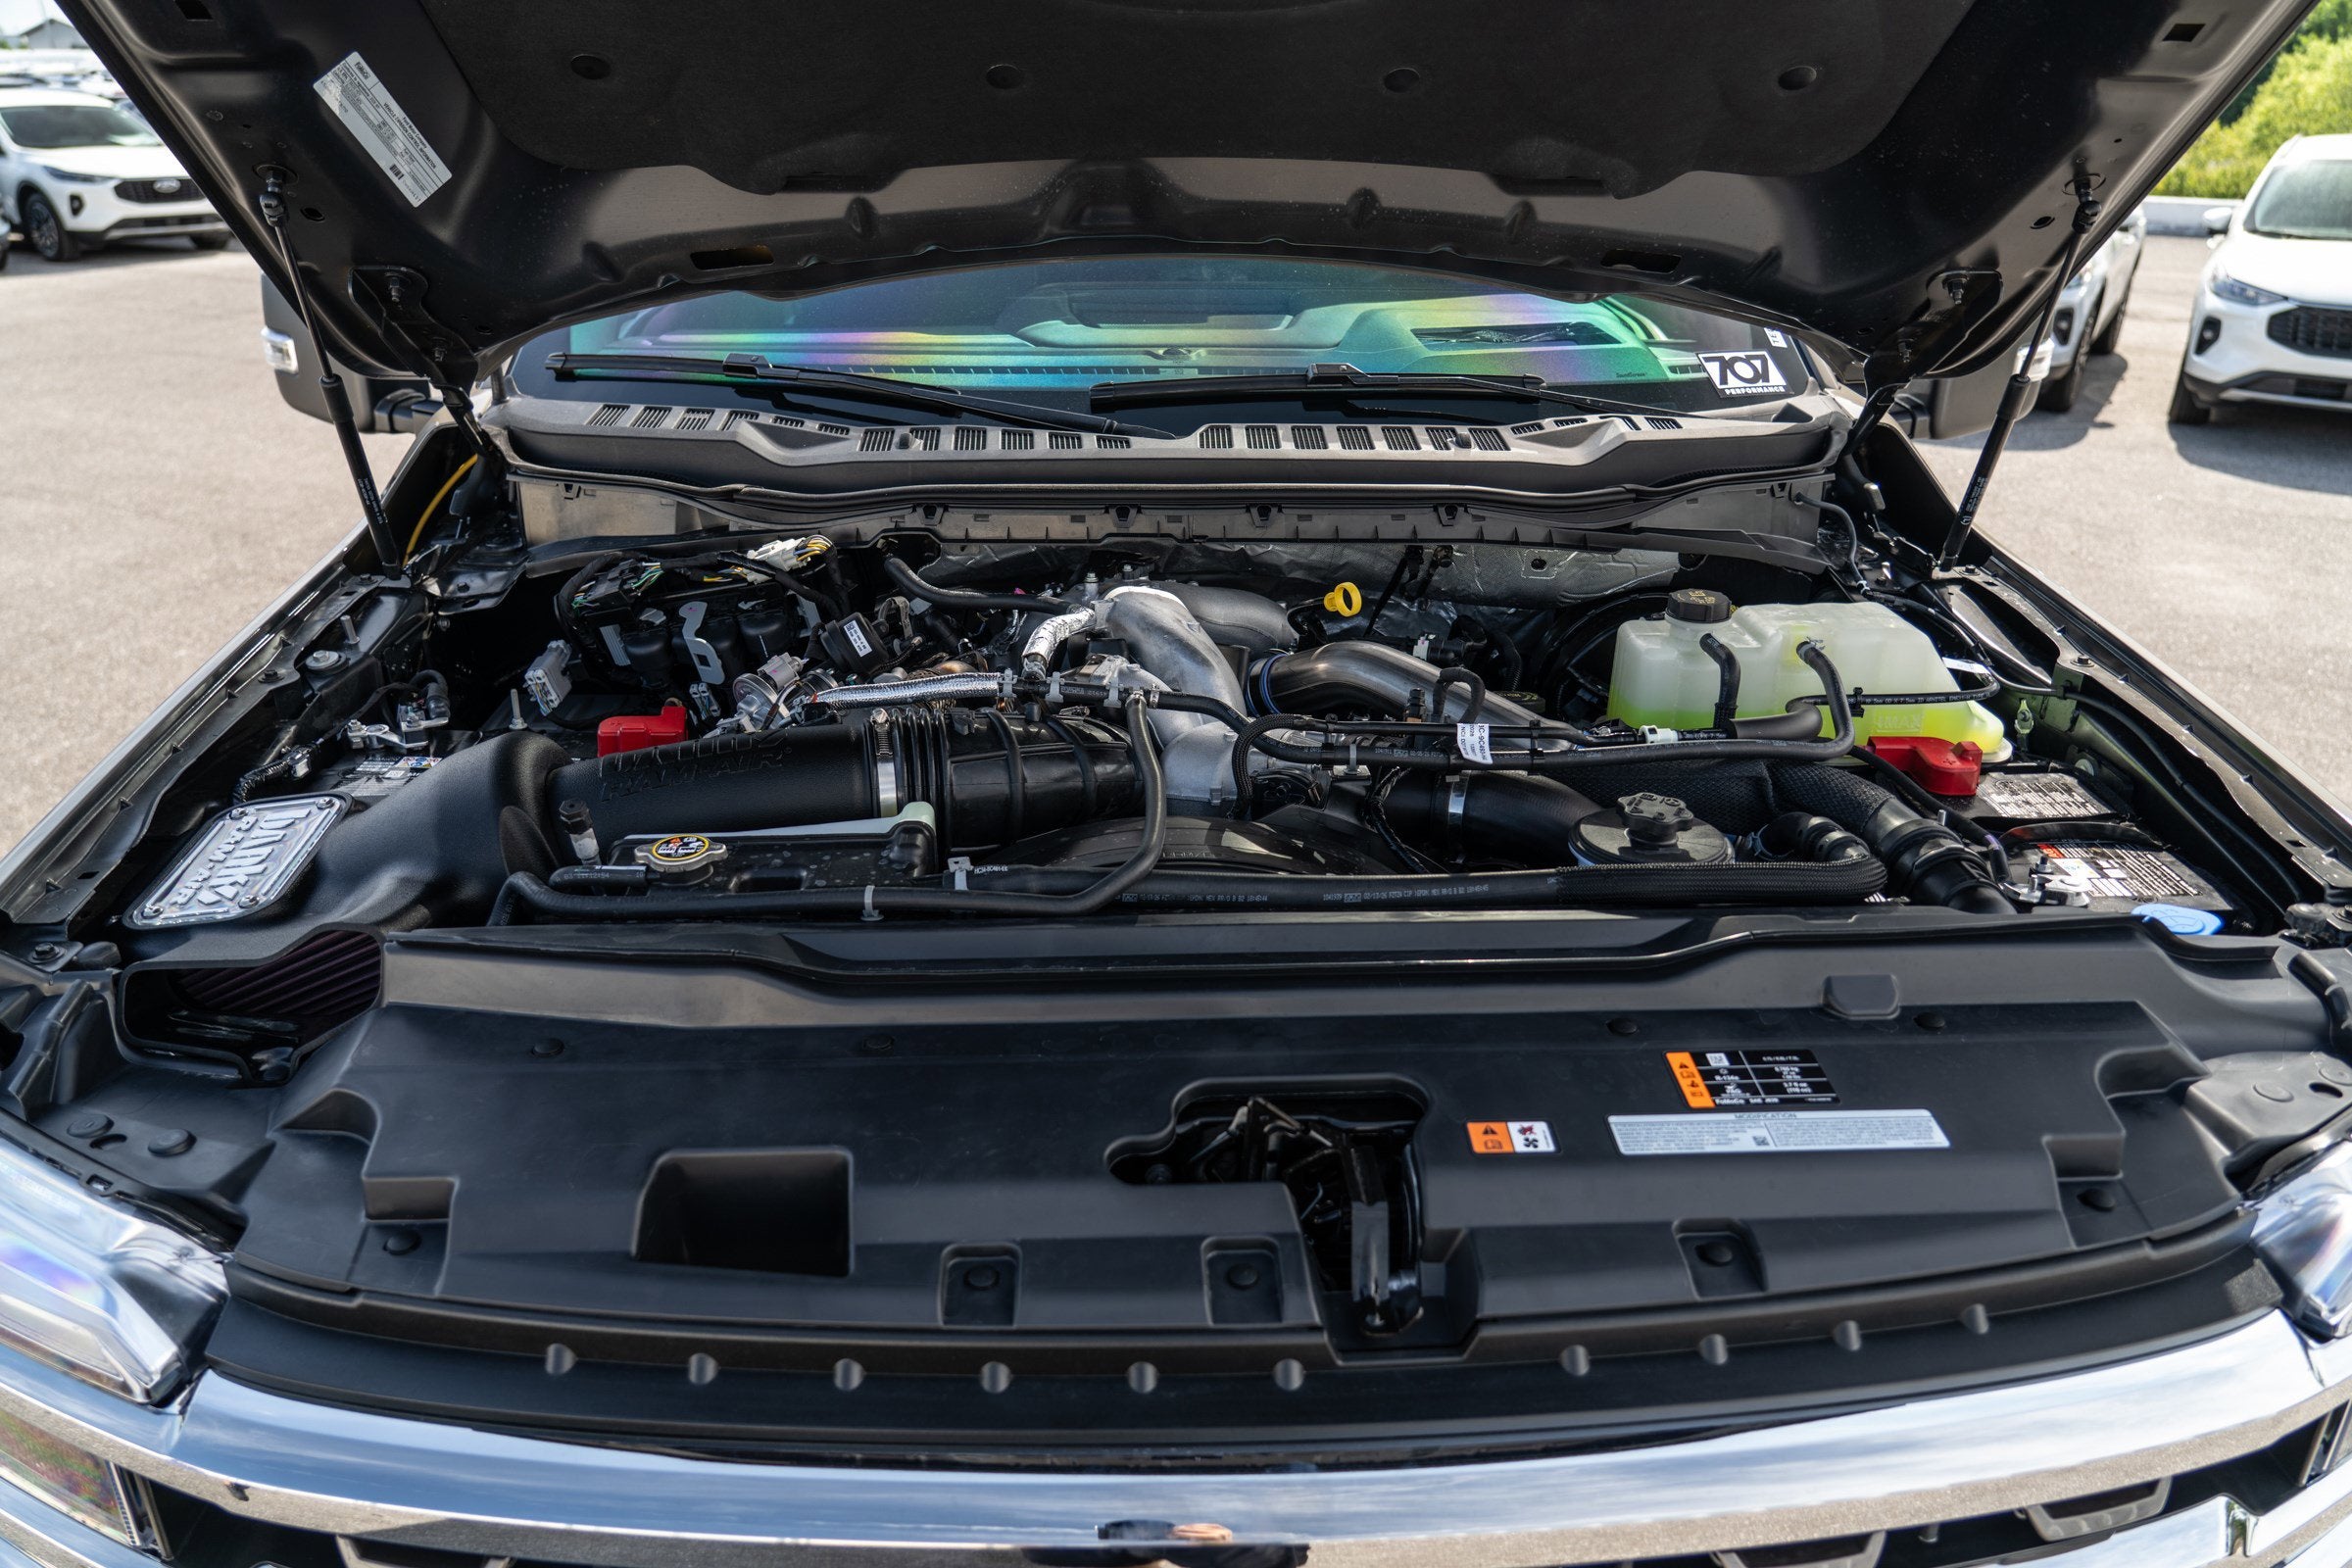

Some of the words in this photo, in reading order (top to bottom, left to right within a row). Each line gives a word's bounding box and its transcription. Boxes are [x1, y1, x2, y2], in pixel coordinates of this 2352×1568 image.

[382, 101, 397, 119] VEHICLE
[407, 131, 420, 148] CONTROL
[418, 147, 437, 170] INFORMATION
[1702, 355, 1770, 385] 707
[1725, 385, 1785, 395] PERFORMANCE
